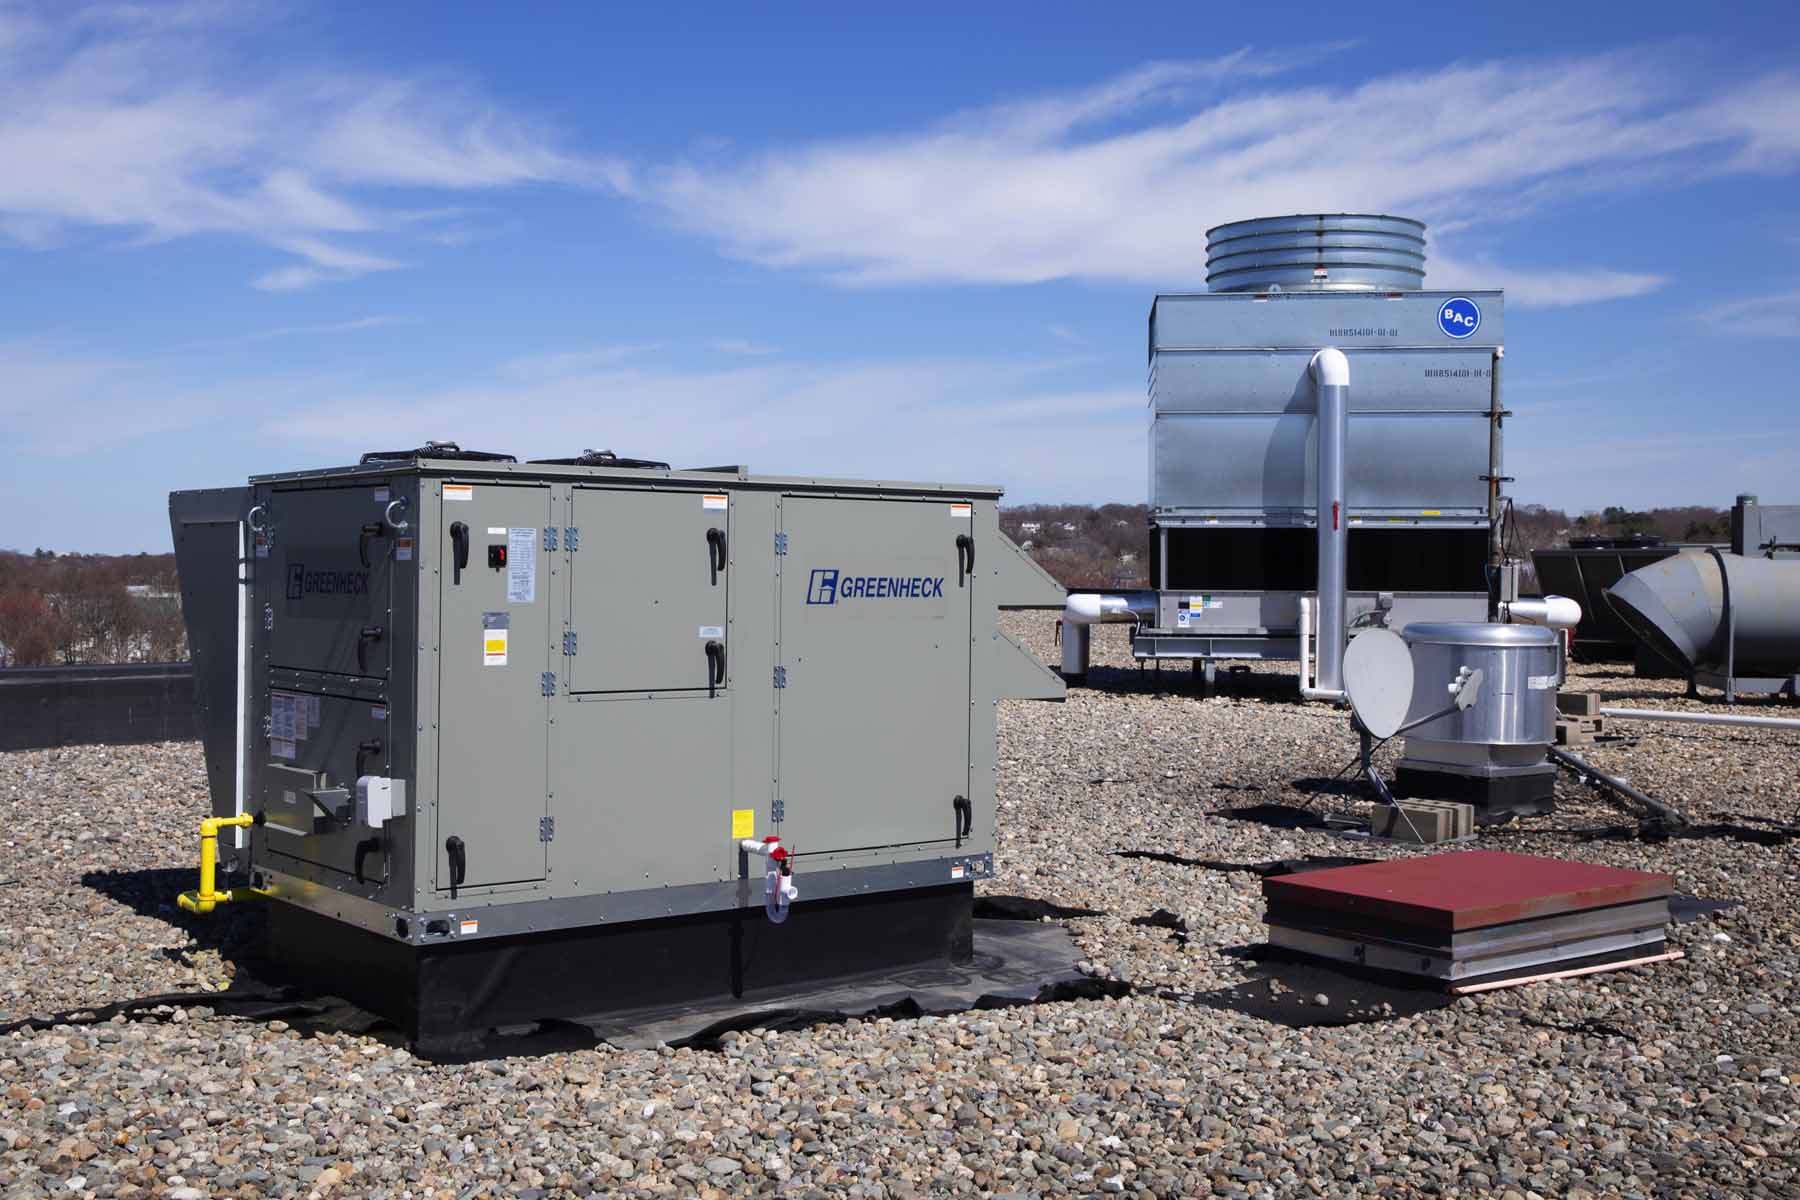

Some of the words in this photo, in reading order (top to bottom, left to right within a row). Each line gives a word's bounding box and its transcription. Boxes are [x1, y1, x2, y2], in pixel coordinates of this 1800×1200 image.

[1444, 308, 1474, 327] BAC
[304, 572, 369, 593] GREENHECK
[841, 577, 945, 598] GREENHECK
